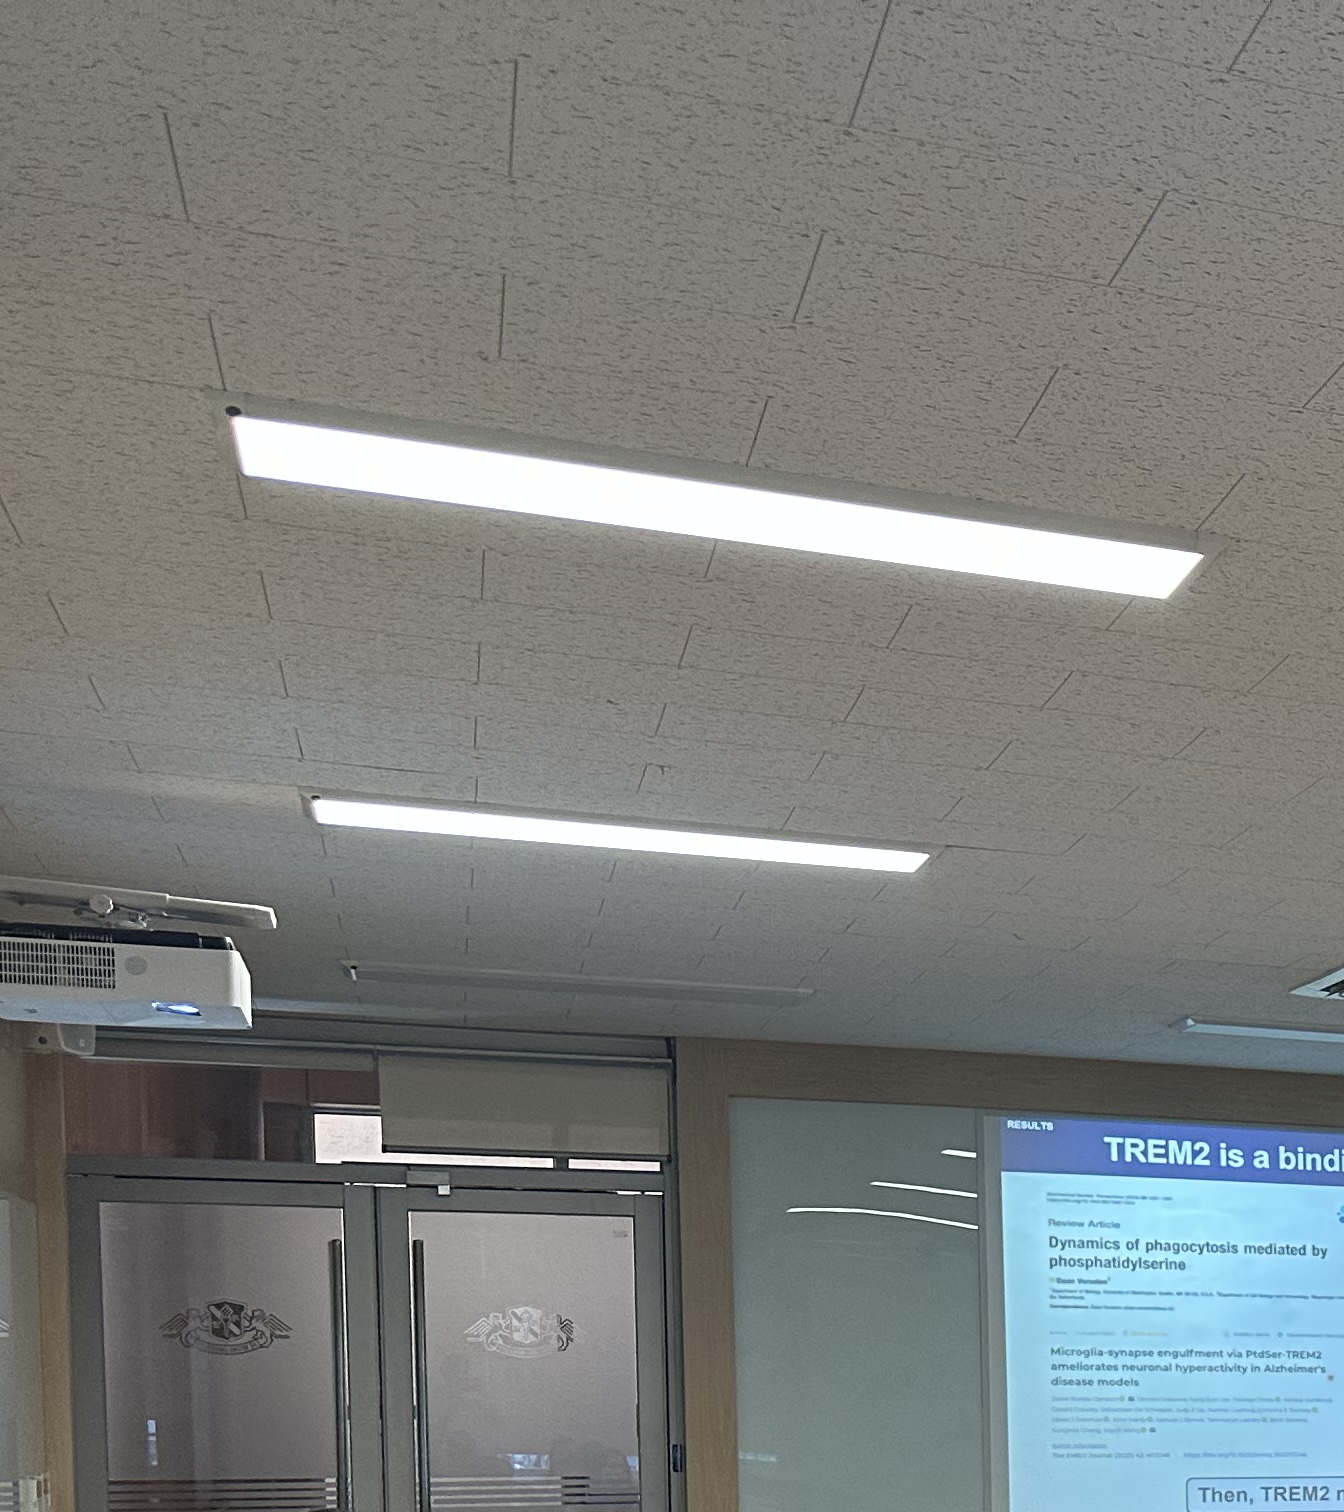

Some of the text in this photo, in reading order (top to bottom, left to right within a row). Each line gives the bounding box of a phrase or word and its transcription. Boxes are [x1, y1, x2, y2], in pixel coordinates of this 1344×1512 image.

[1007, 1119, 1054, 1131] RESULTS
[1103, 1136, 1211, 1167] TREM2
[1219, 1142, 1245, 1168] is
[1252, 1149, 1270, 1169] a
[1048, 1218, 1121, 1229] Review Article
[1048, 1235, 1328, 1259] Dynamics of phagocytosis mediated by
[1049, 1255, 1187, 1272] phosphatidylserine
[1050, 1346, 1323, 1360] Microglia-synapse engulfment via PtdSer-TREM2
[1050, 1362, 1327, 1375] ameliorates neuronal hyperactivity in Alzheimer's
[1050, 1376, 1140, 1388] disease models
[1197, 1486, 1254, 1505] Then,
[1261, 1485, 1330, 1502] TREM2
